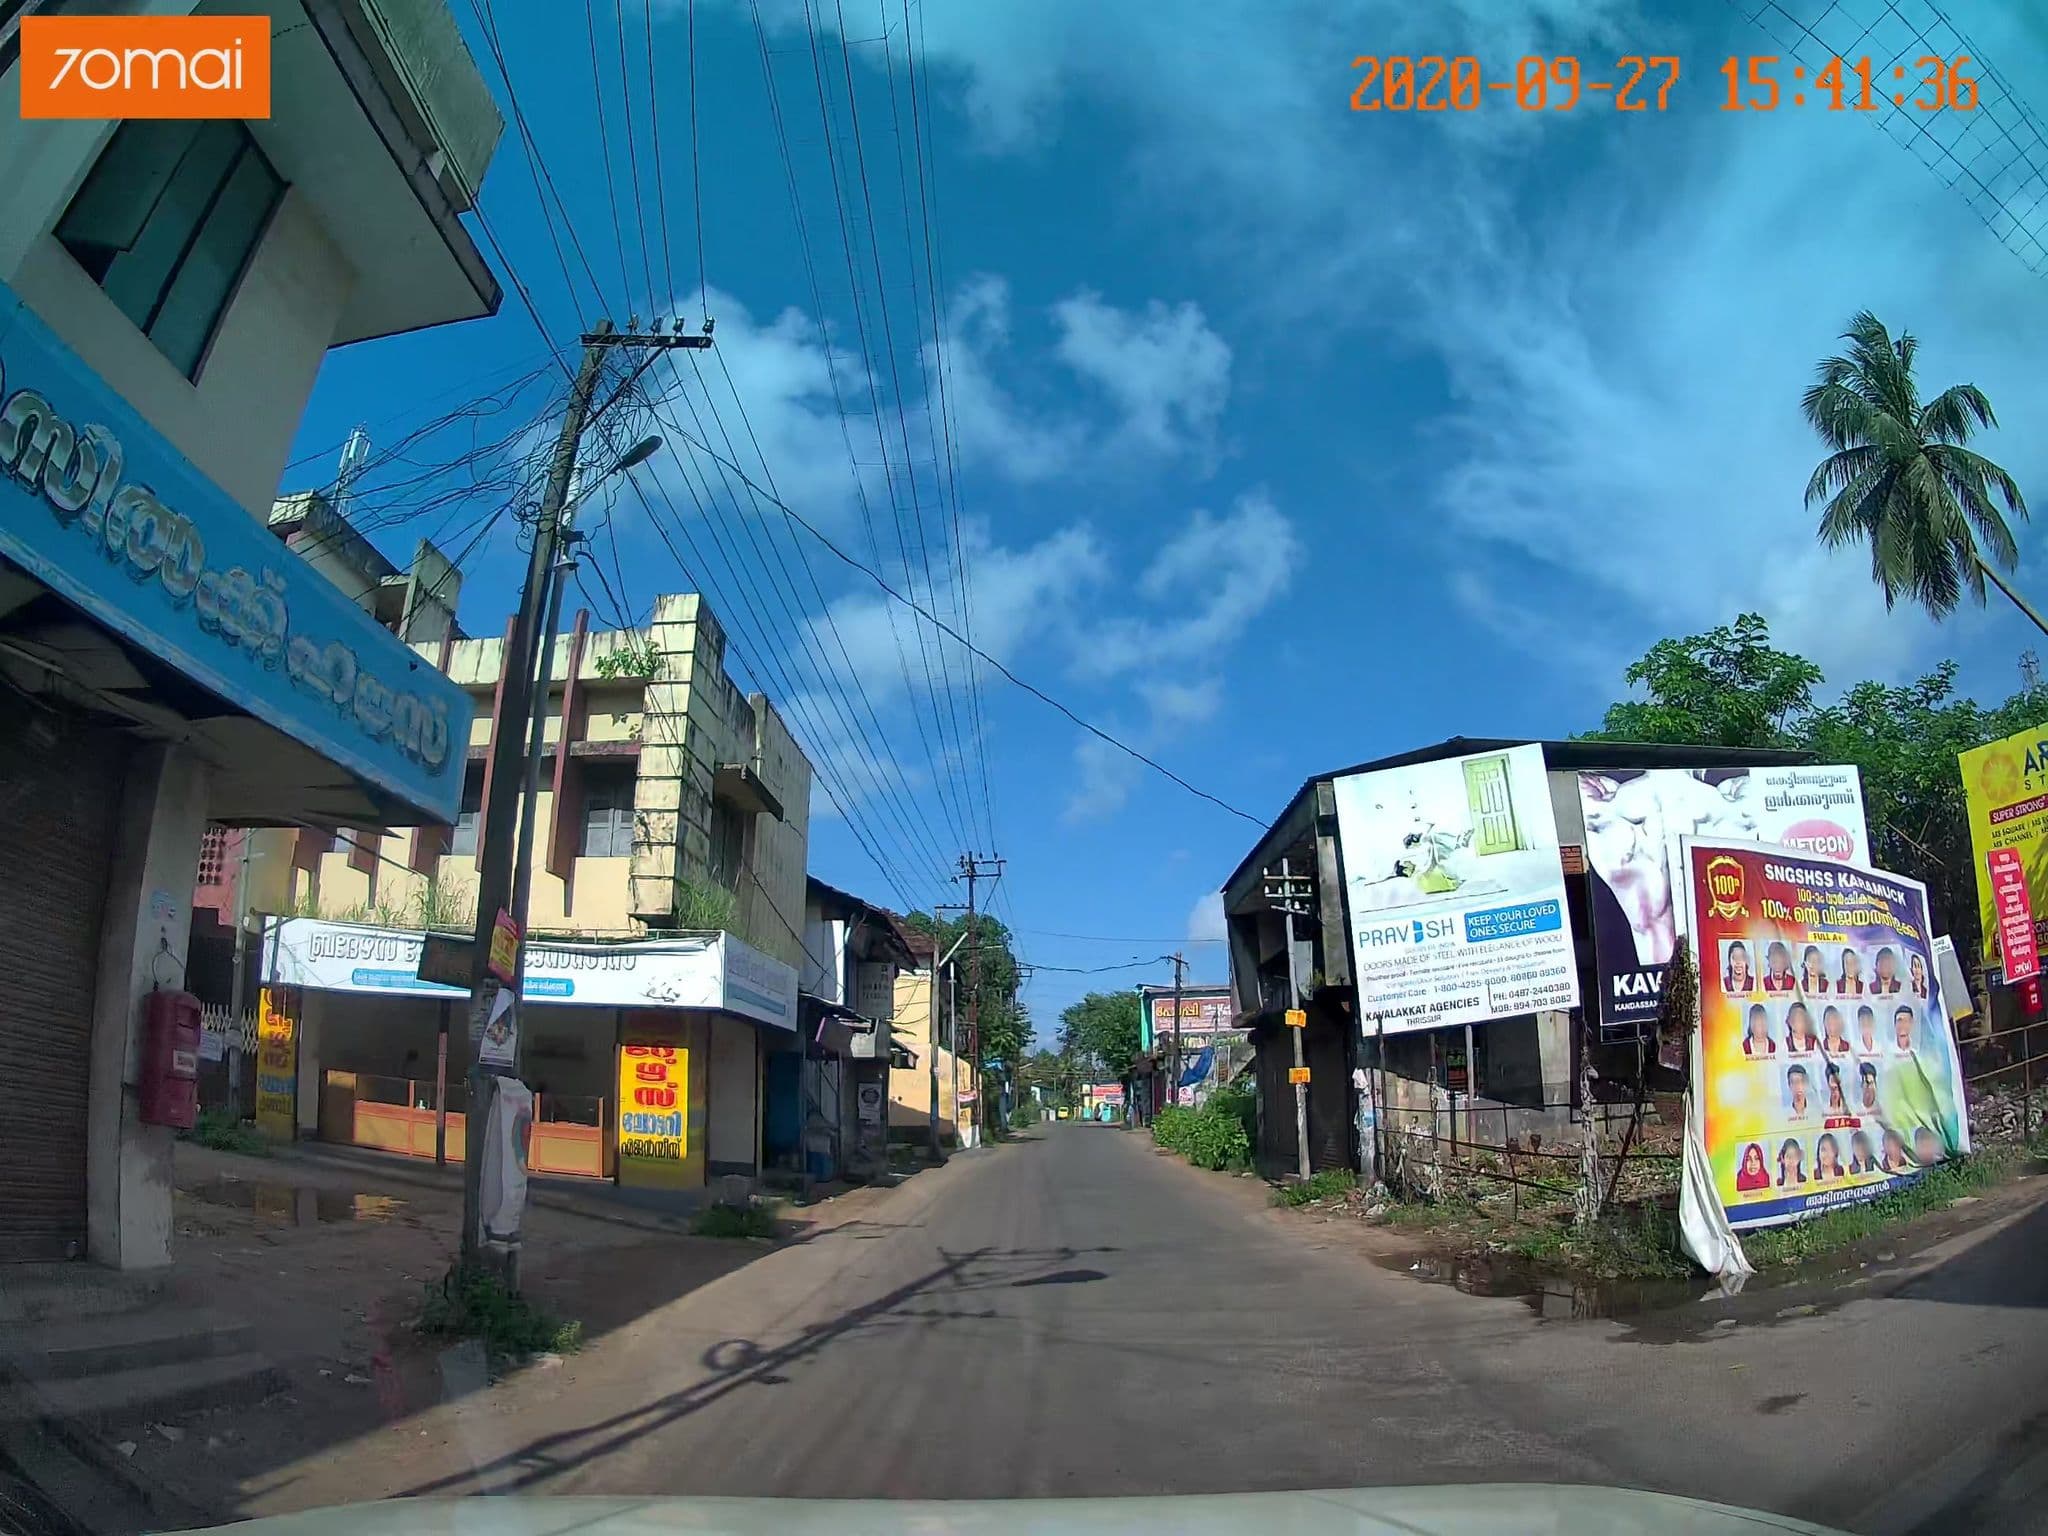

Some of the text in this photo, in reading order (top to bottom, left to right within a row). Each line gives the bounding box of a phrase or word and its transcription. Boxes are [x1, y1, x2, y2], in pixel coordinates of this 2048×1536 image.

[1992, 807, 2014, 823] SUPER
[1765, 863, 1907, 907] SNGSHSS KARAMUCK
[1468, 904, 1556, 927] KEEP YOUR LOVED
[1470, 918, 1537, 938] ONES SECURE
[1367, 992, 1407, 1003] Customer
[1365, 996, 1480, 1022] KAVALAKKAT AGENCIES
[1406, 1013, 1442, 1026] THRISSUR
